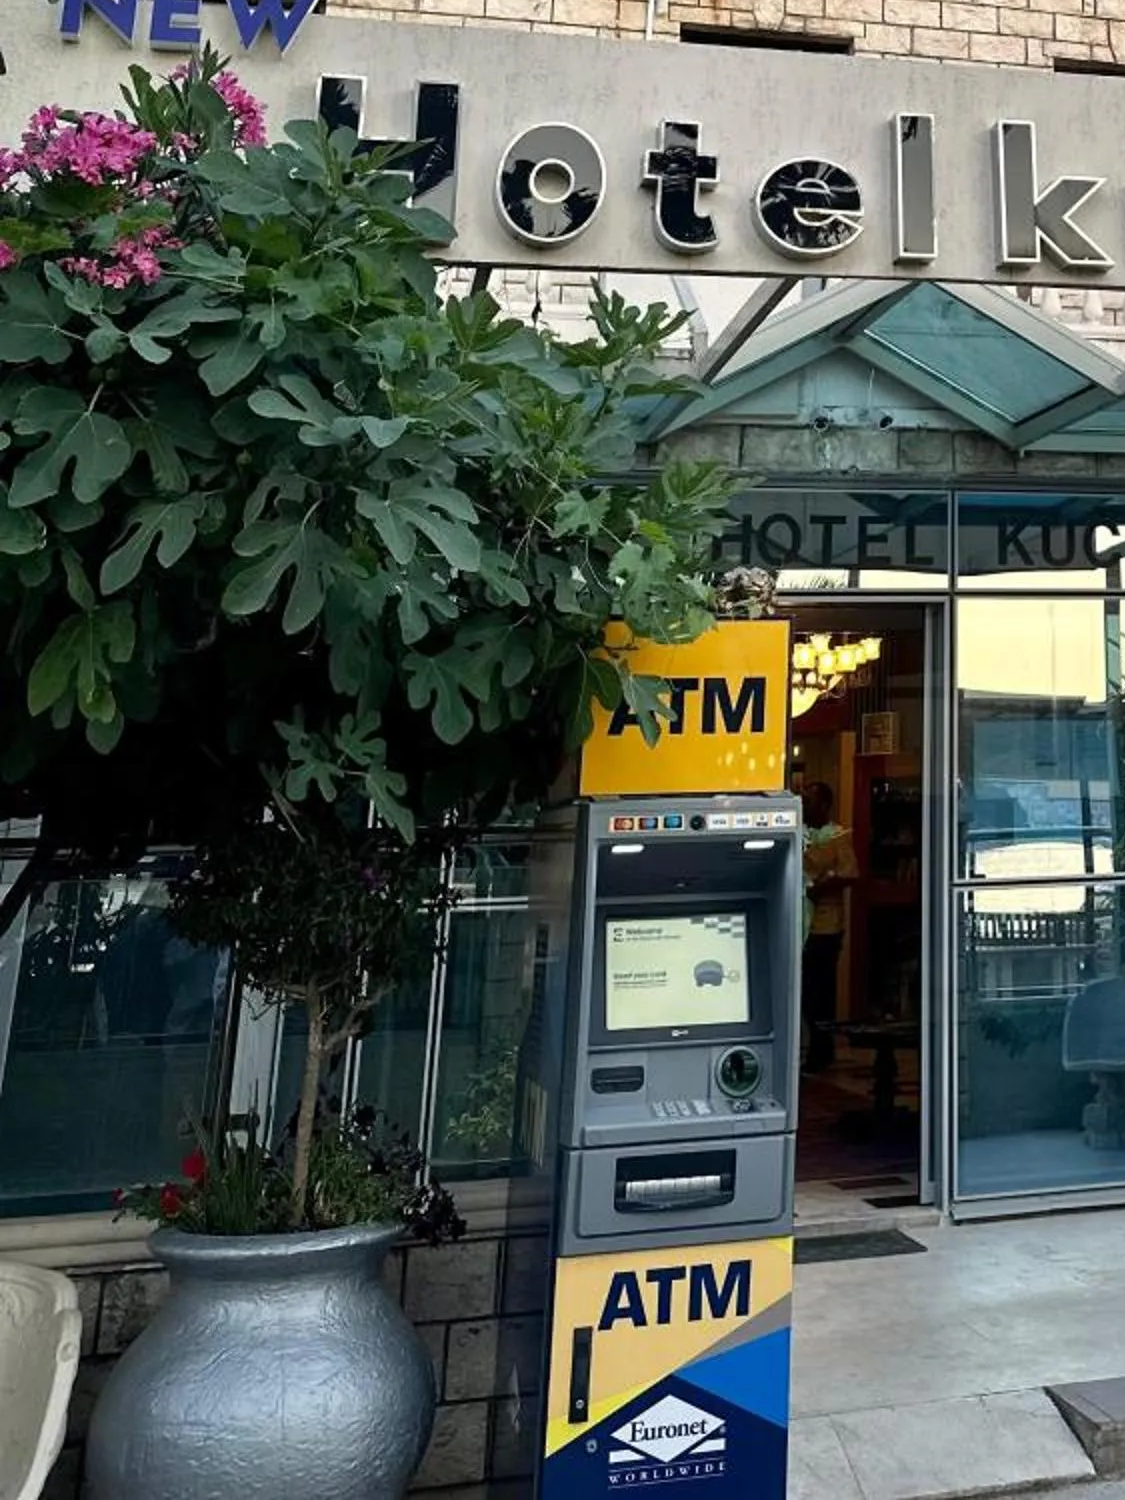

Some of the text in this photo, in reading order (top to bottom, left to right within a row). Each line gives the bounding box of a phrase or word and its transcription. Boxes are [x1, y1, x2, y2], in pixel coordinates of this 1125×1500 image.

[315, 73, 939, 263] Hotel
[711, 512, 933, 567] HOTEL
[598, 1260, 752, 1330] ATM
[630, 1419, 708, 1442] Euronet
[608, 1462, 726, 1484] WORLDWIDE
